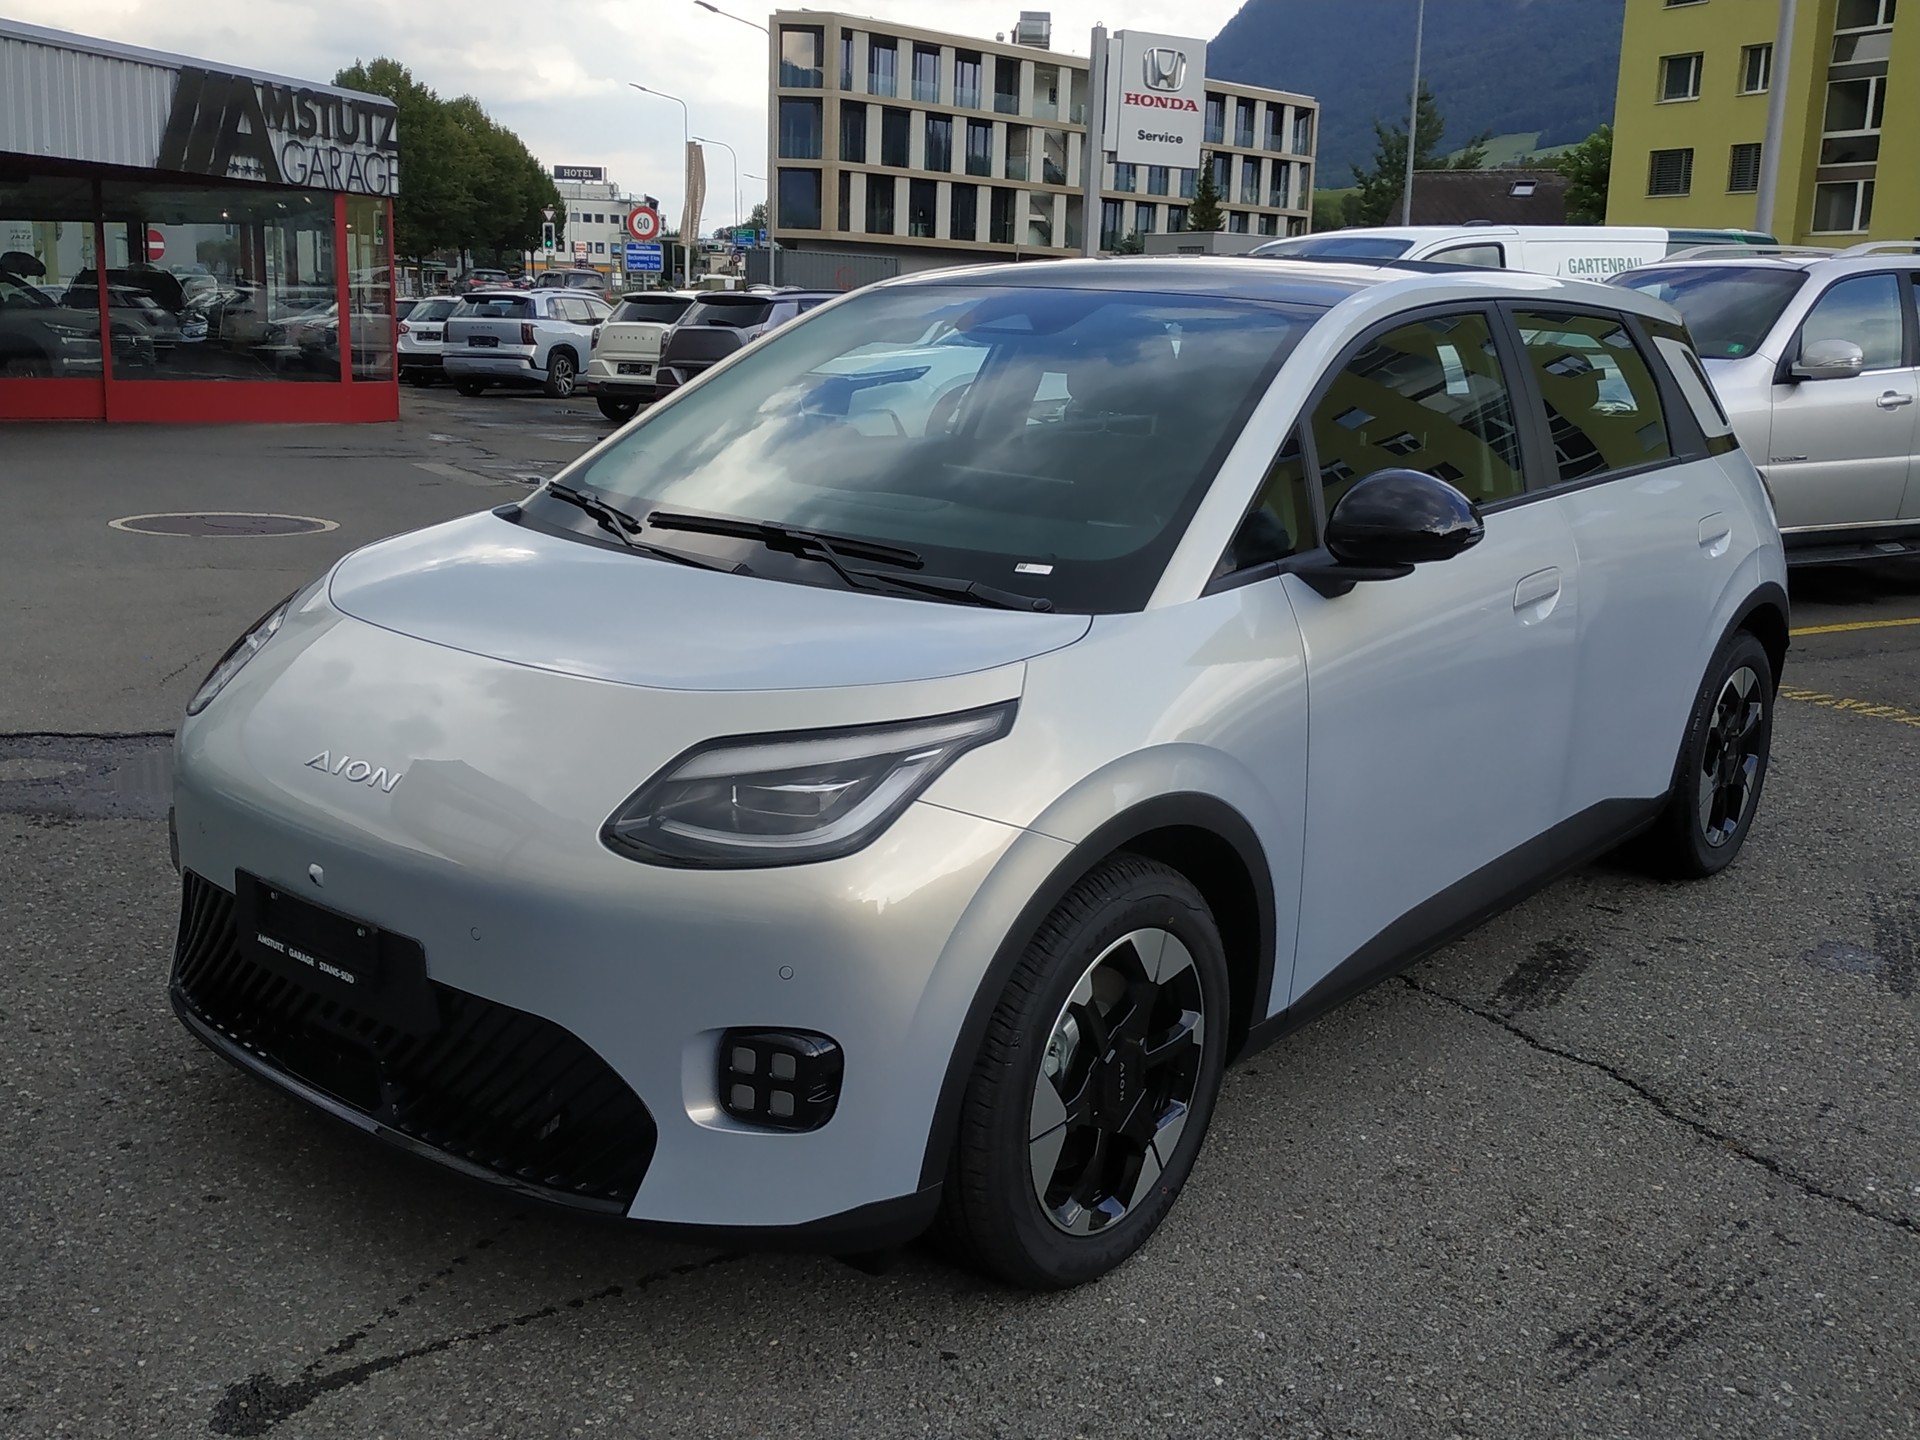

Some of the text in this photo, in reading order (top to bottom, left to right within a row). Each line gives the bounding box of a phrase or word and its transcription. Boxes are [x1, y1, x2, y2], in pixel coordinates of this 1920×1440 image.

[1124, 93, 1199, 112] HONDA
[1137, 130, 1184, 144] Service
[281, 140, 399, 197] GARAGE
[563, 169, 594, 178] HOTEL
[637, 217, 650, 230] 60
[304, 750, 403, 793] AION
[257, 934, 285, 953] AMSTUTZ
[288, 948, 315, 967] GARAGE
